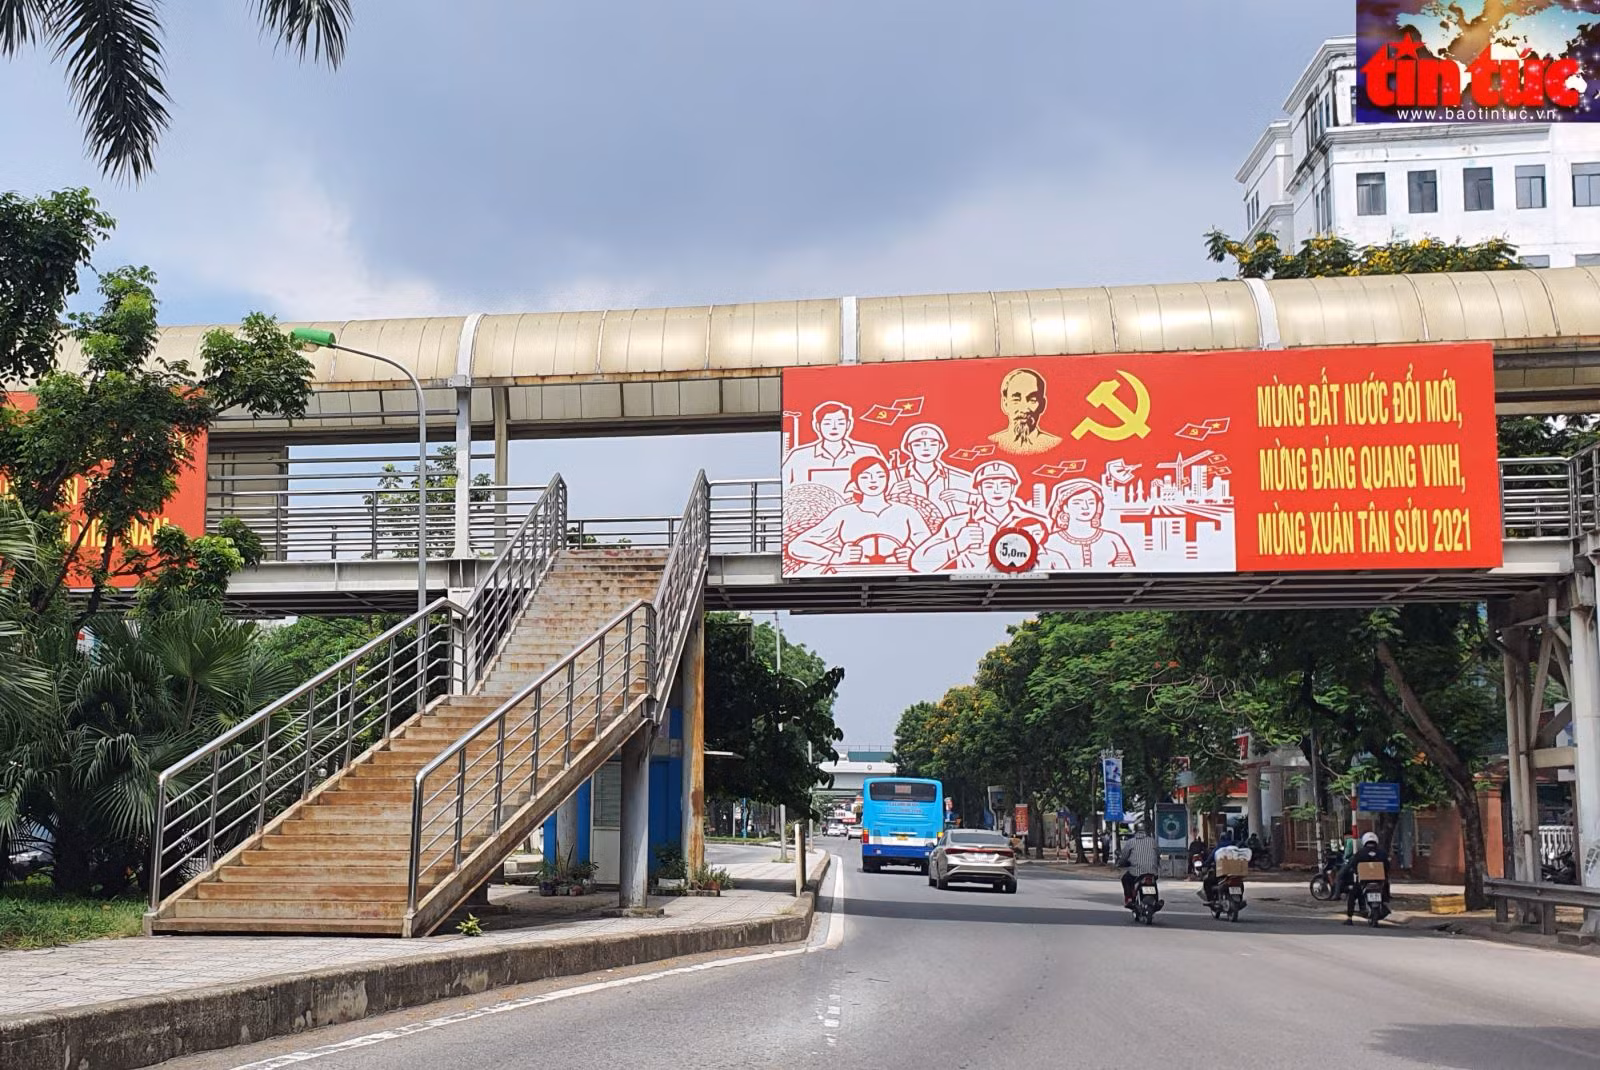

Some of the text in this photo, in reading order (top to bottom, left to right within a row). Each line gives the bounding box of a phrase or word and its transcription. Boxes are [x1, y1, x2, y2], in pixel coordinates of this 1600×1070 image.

[1257, 363, 1463, 429] MỪNG ĐẤT NƯỚC ĐỔI MỚI,
[1259, 435, 1466, 493] MỪNG ĐẢNG QUANG VINH,
[1257, 497, 1472, 556] MỪNG XUÂN TÂN SỬU 2021
